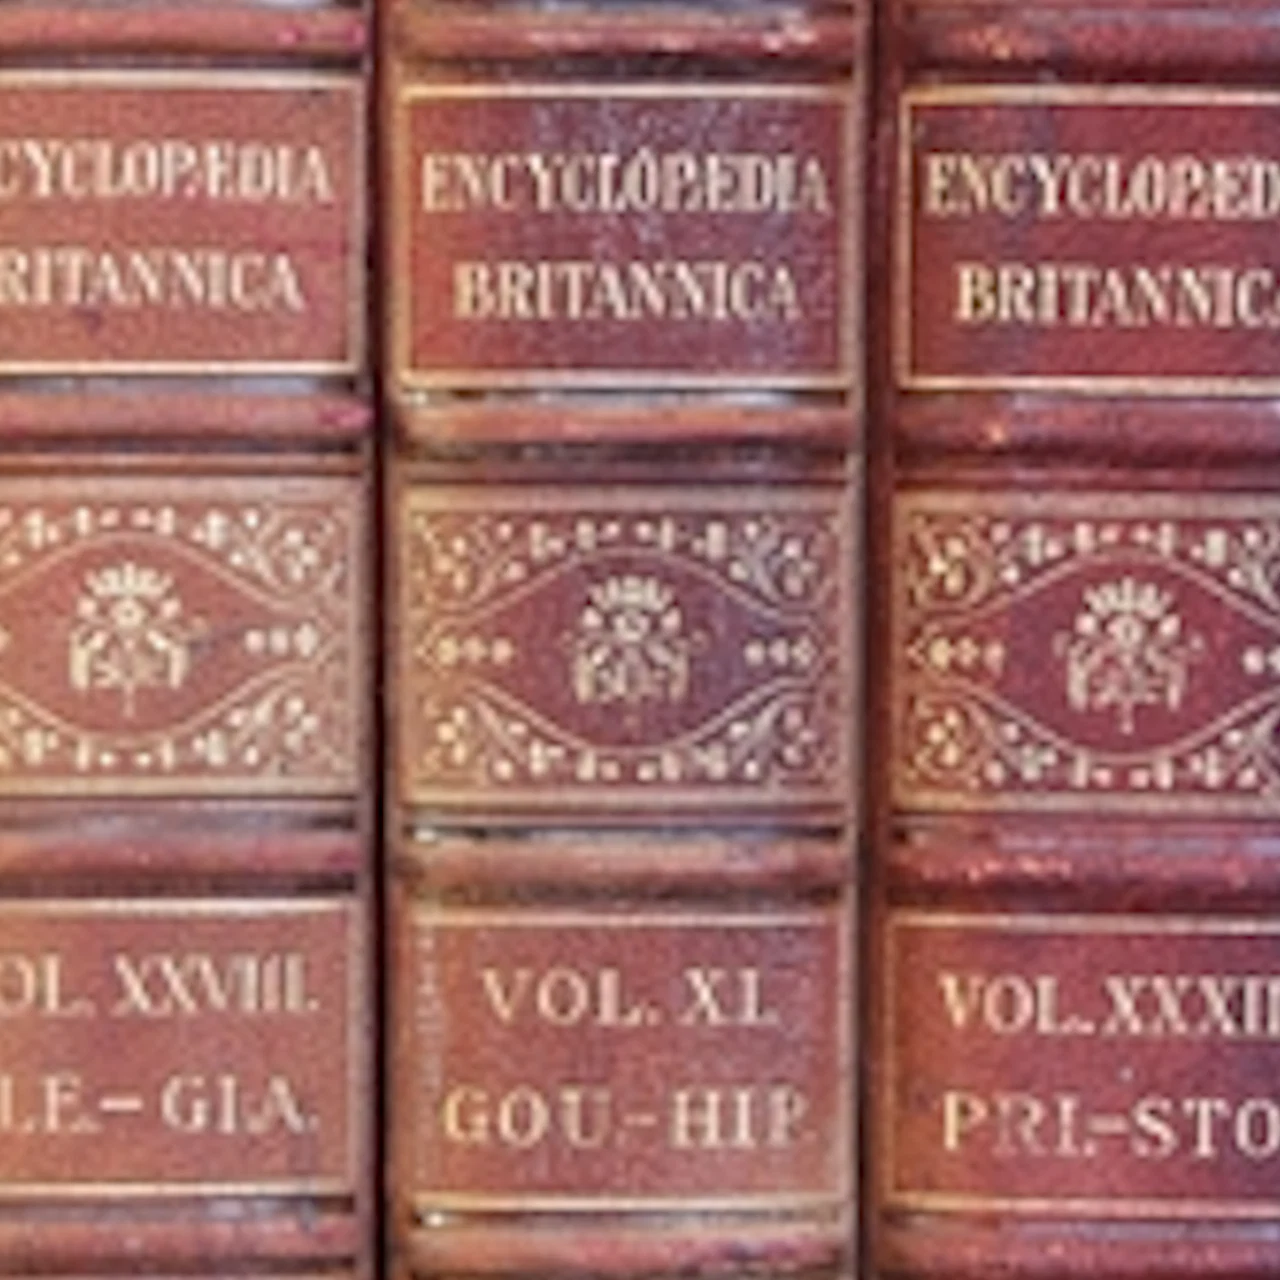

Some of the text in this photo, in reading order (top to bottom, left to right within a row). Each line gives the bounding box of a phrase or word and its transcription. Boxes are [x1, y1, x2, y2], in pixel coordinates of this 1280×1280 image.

[422, 150, 830, 216] ENCYCLOPÆDIA
[453, 260, 802, 320] BRITANNICA
[481, 967, 661, 1026] VOL.
